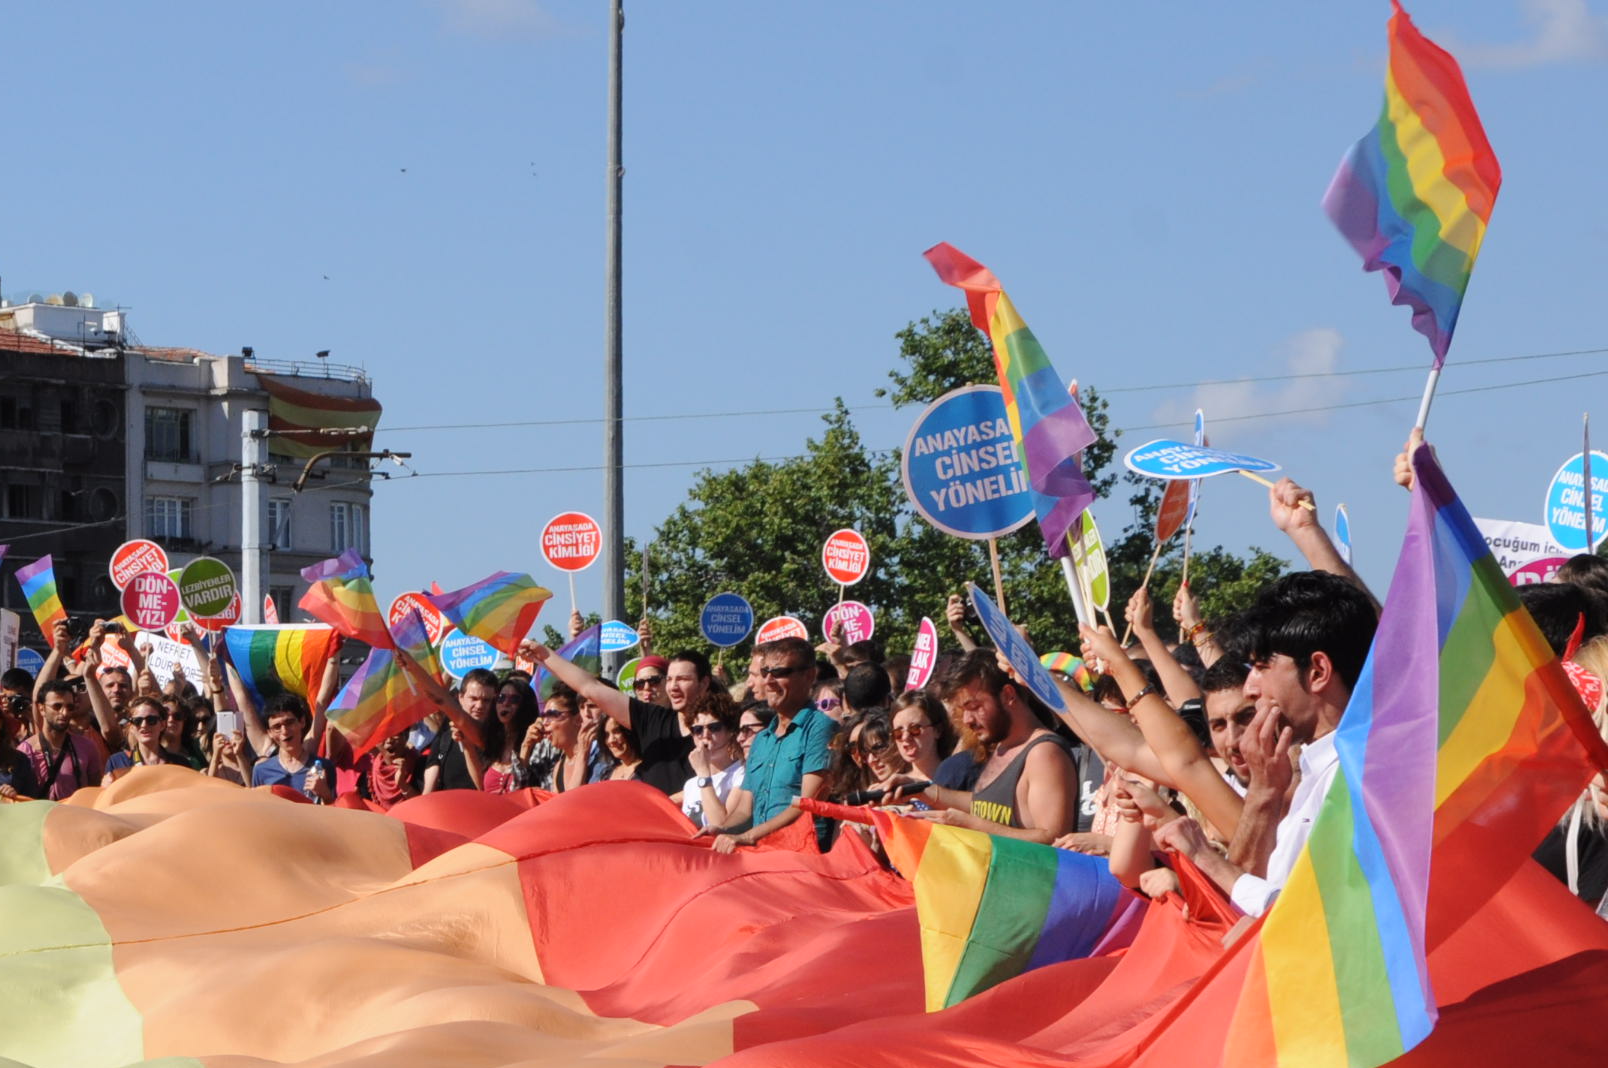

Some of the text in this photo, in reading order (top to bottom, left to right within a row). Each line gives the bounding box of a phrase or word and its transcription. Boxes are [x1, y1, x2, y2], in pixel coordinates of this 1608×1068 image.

[915, 418, 1011, 456] ANAYASA
[1561, 487, 1604, 511] CİNEL
[549, 522, 594, 532] ANAYASADA
[1552, 506, 1606, 533] YÖNEİM
[545, 531, 597, 546] CİNSİYET
[1484, 536, 1540, 552] ocuğum
[827, 546, 864, 561] CİNSİYET
[116, 547, 158, 583] CİNSİYET
[135, 575, 173, 594] DÖN-
[181, 574, 231, 594] LEZBİYENLER
[139, 593, 167, 609] ME-
[184, 585, 232, 608] VARDIR
[711, 613, 743, 622] CİNSEL
[707, 623, 746, 633] YÖNELİM
[158, 640, 192, 659] NEFRET
[452, 645, 488, 657] CİNSEL
[450, 655, 493, 669] YÖNELİM
[911, 650, 930, 669] LAK
